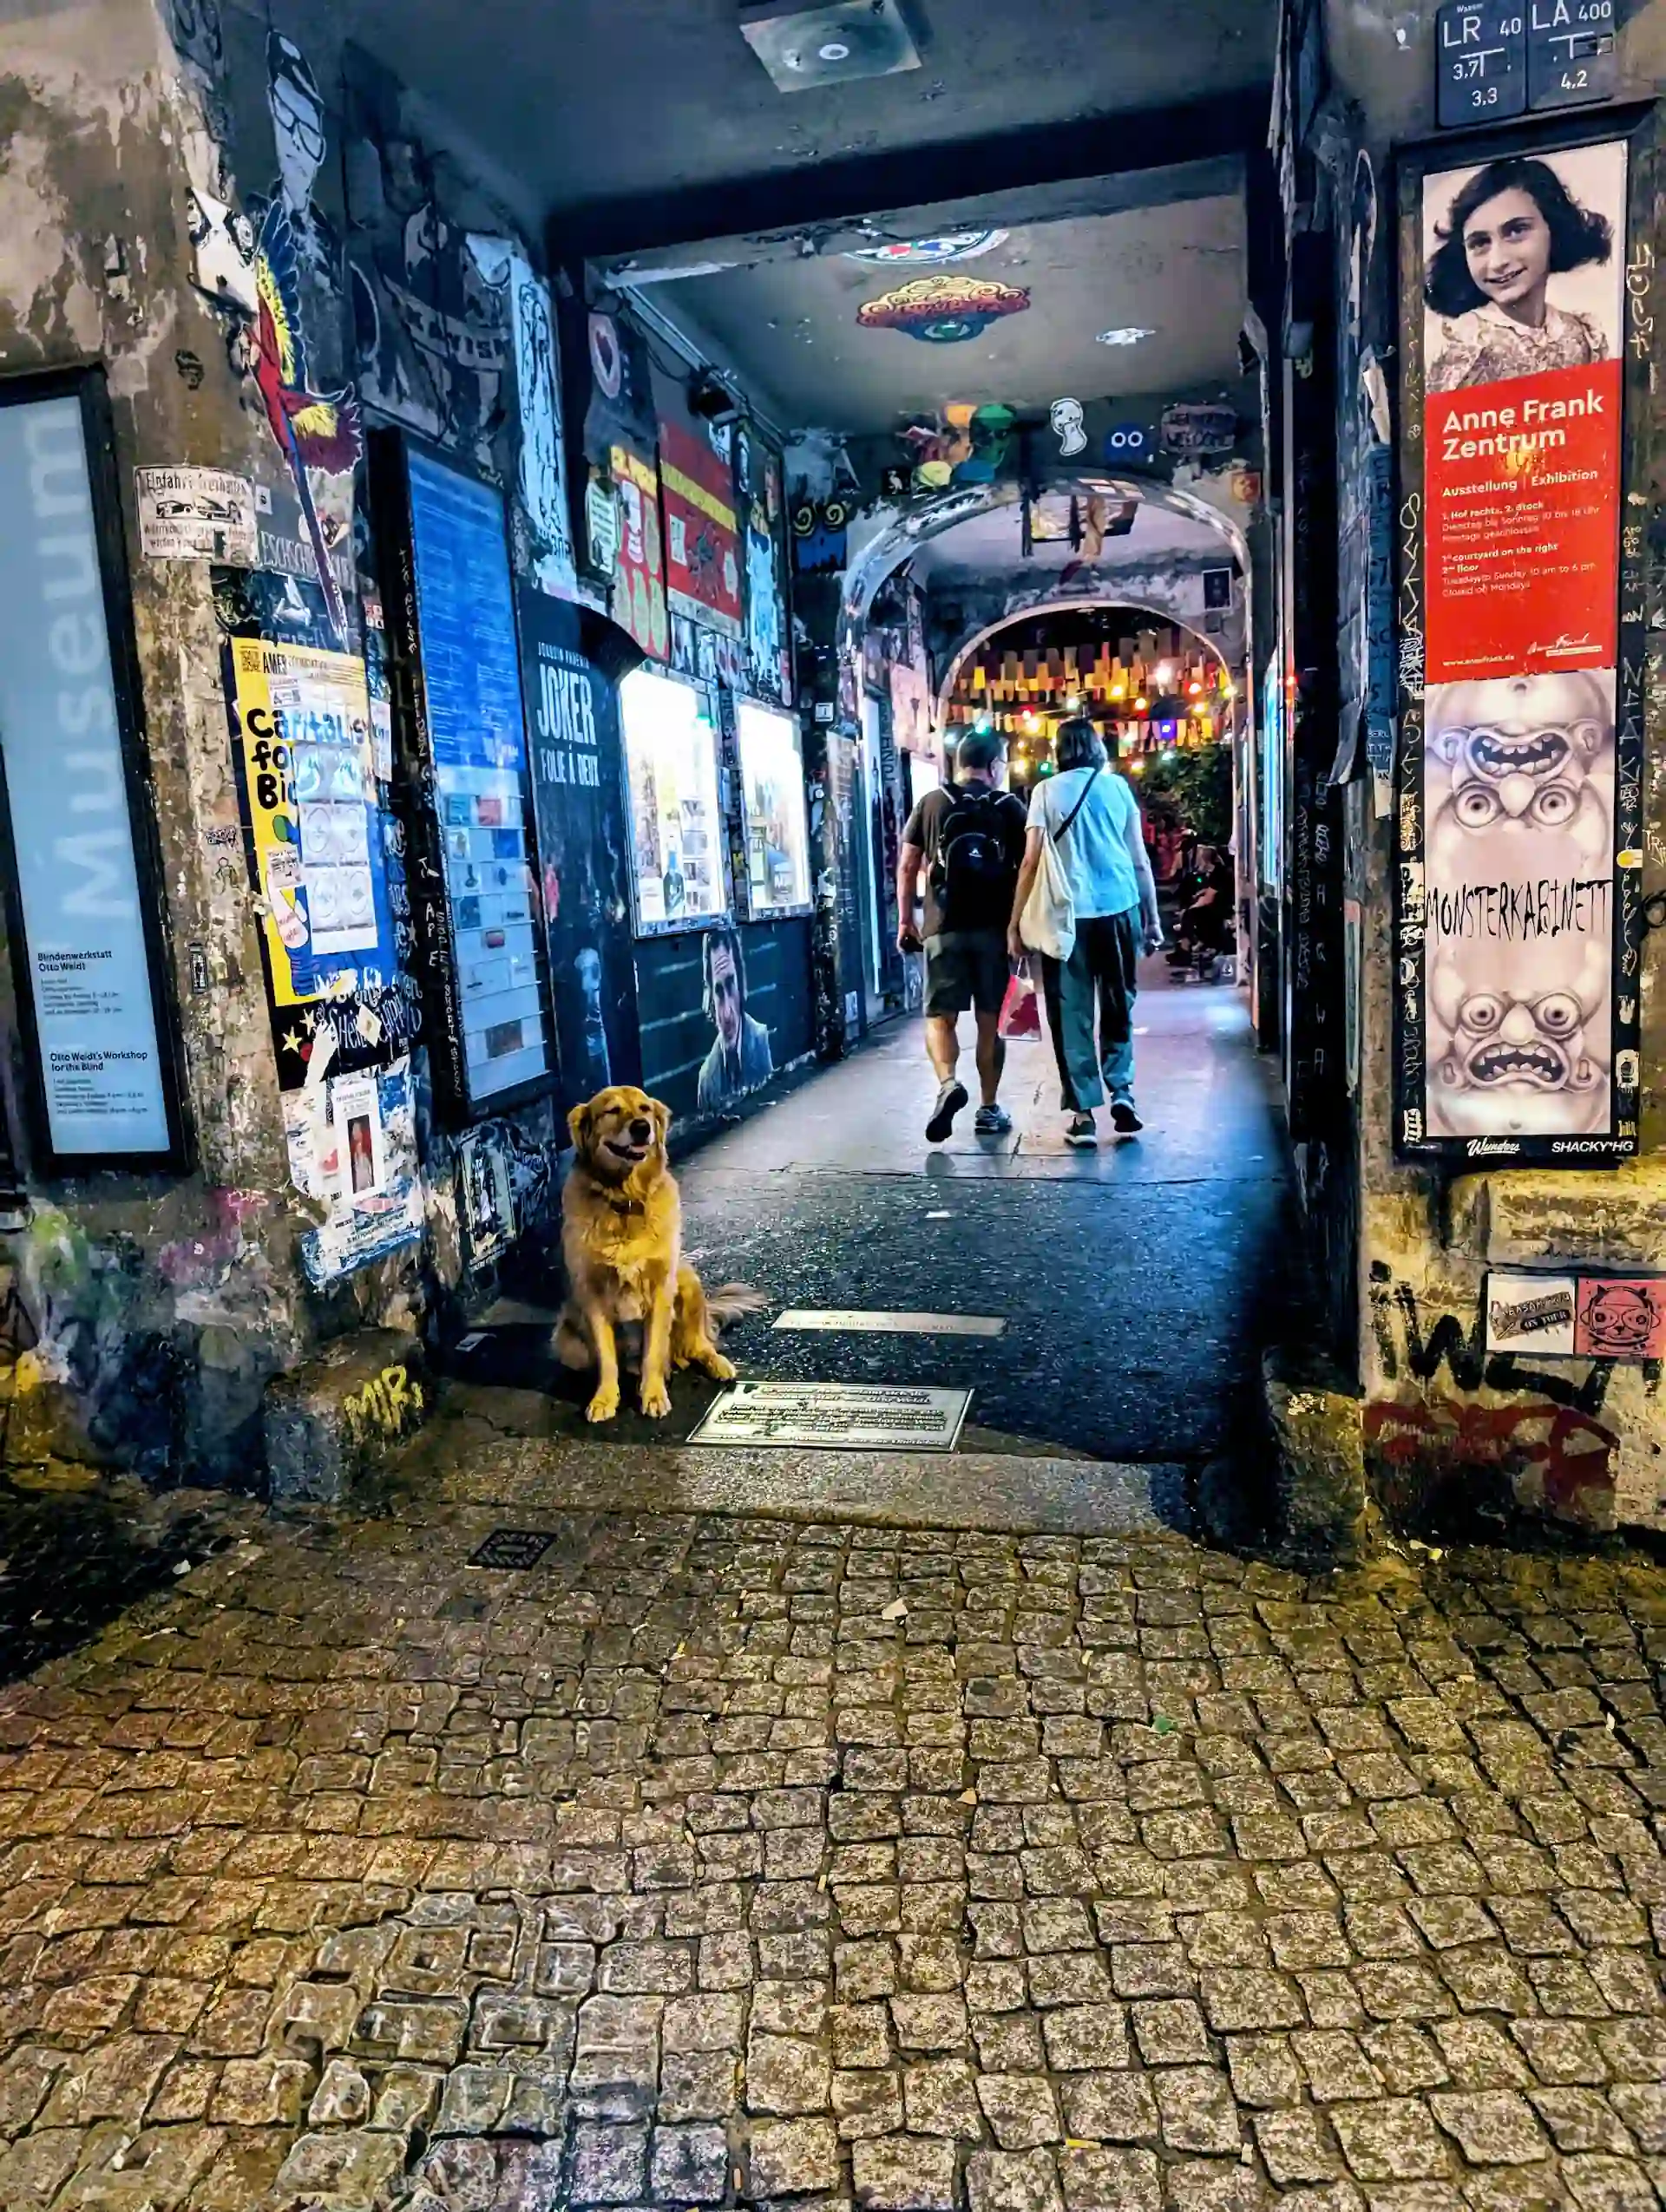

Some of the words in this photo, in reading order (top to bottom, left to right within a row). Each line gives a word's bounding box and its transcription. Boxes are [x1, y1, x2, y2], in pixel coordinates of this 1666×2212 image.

[1532, 0, 1571, 30] LA
[1578, 3, 1611, 21] 400
[1444, 16, 1481, 48] LR
[1499, 17, 1521, 36] 40
[1443, 406, 1515, 433] Anne
[1524, 389, 1604, 423] Frank
[1441, 428, 1565, 461] Zentrum
[1442, 478, 1518, 498] Ausstellung
[1532, 468, 1598, 487] Exhibition
[1453, 549, 1499, 562] courtyard
[1501, 548, 1514, 557] on
[1516, 544, 1532, 554] the
[1534, 542, 1559, 553] right
[1457, 563, 1479, 573] floor
[24, 412, 134, 914] Museum
[536, 663, 597, 746] JOKER
[540, 747, 567, 783] FOLIE
[1423, 874, 1614, 946] MONSTERKABINETT
[37, 951, 112, 962] Blindenwerkstatt
[38, 962, 59, 972] Otto
[60, 961, 85, 971] Weidt
[49, 1051, 69, 1062] Otto
[103, 1050, 148, 1062] Workshop
[51, 1063, 66, 1072] for
[66, 1062, 80, 1071] the
[82, 1061, 103, 1071] Blind
